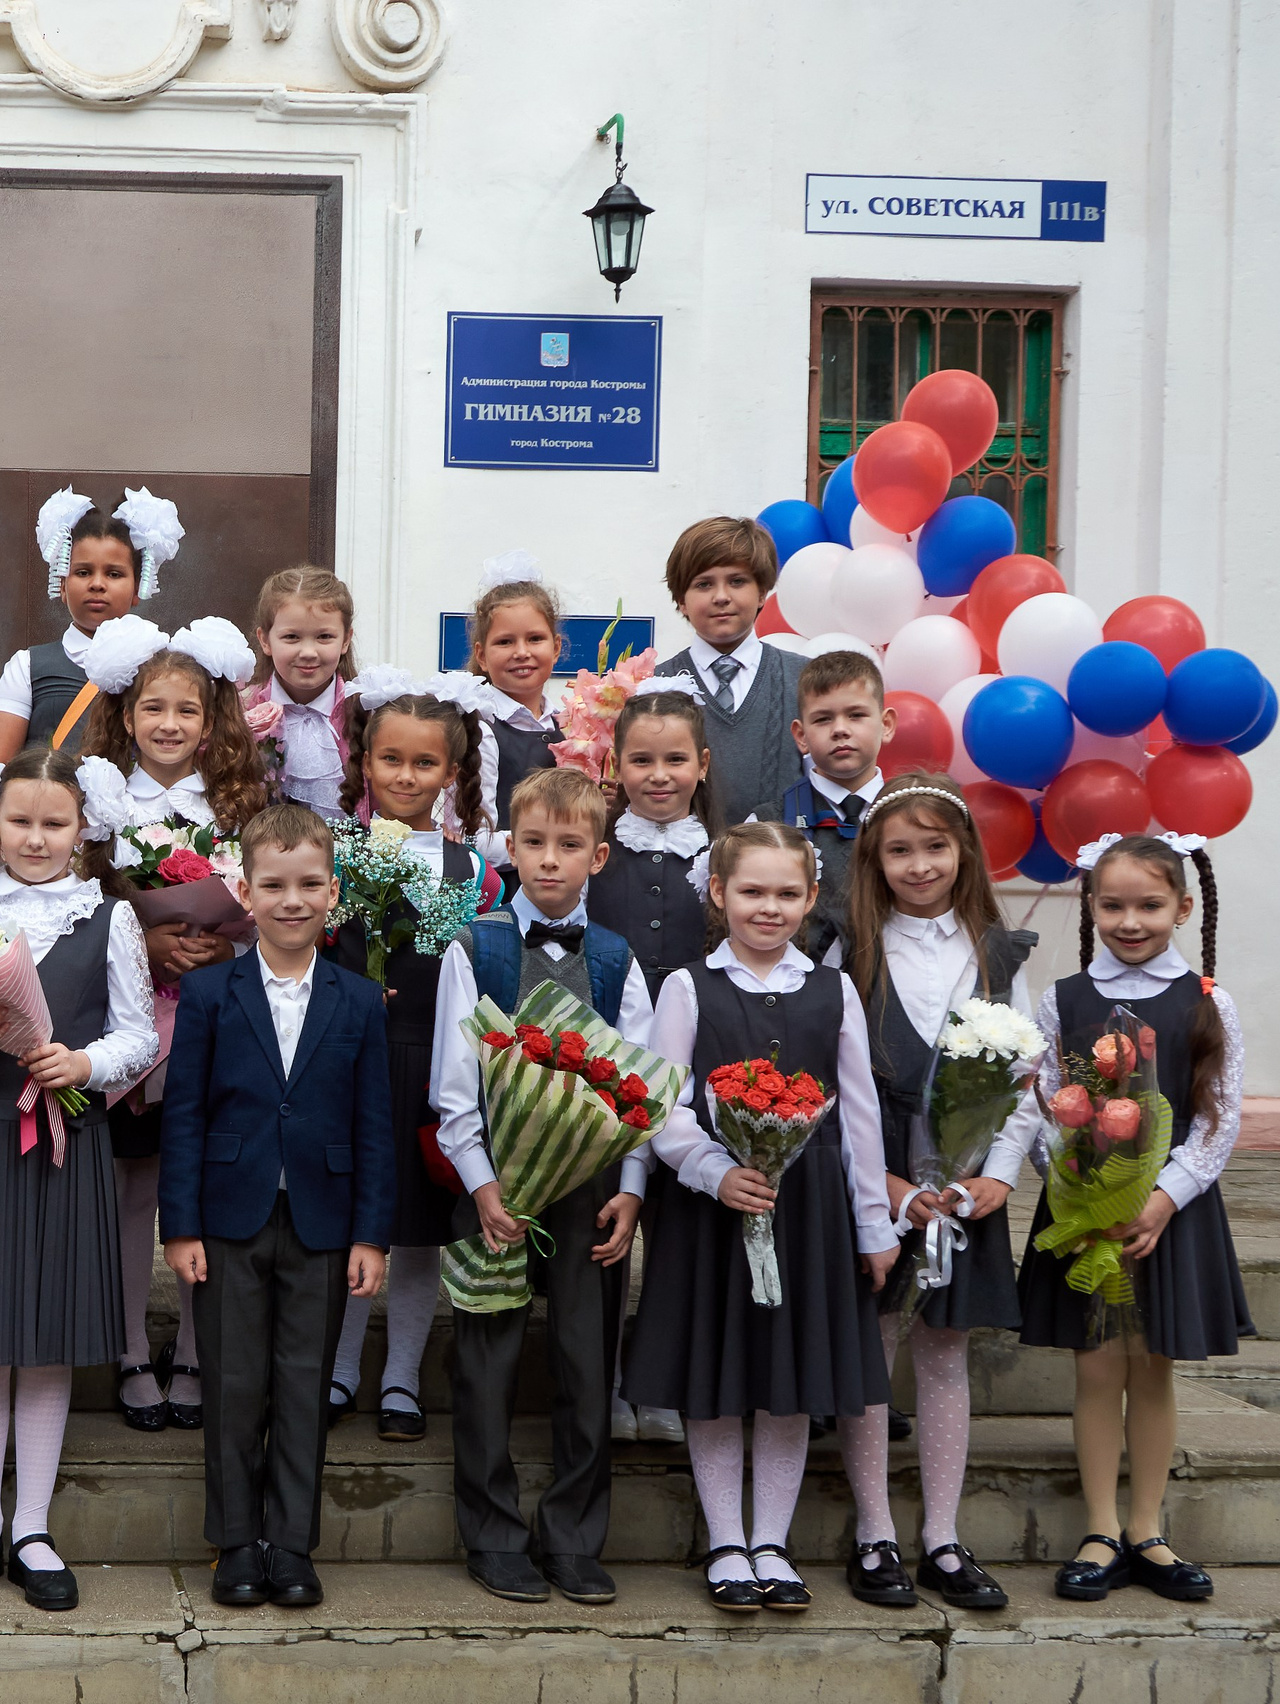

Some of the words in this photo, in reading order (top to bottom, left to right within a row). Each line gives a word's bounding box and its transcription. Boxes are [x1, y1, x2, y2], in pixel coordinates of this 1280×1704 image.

[821, 200, 858, 219] ул.
[868, 196, 1026, 219] СОВЕТСКАЯ
[460, 376, 548, 389] Администрация
[549, 380, 588, 390] города
[590, 379, 646, 391] Костромы
[464, 403, 592, 423] ГИМНАЗИЯ
[510, 438, 538, 449] город
[540, 438, 594, 450] Кострома
